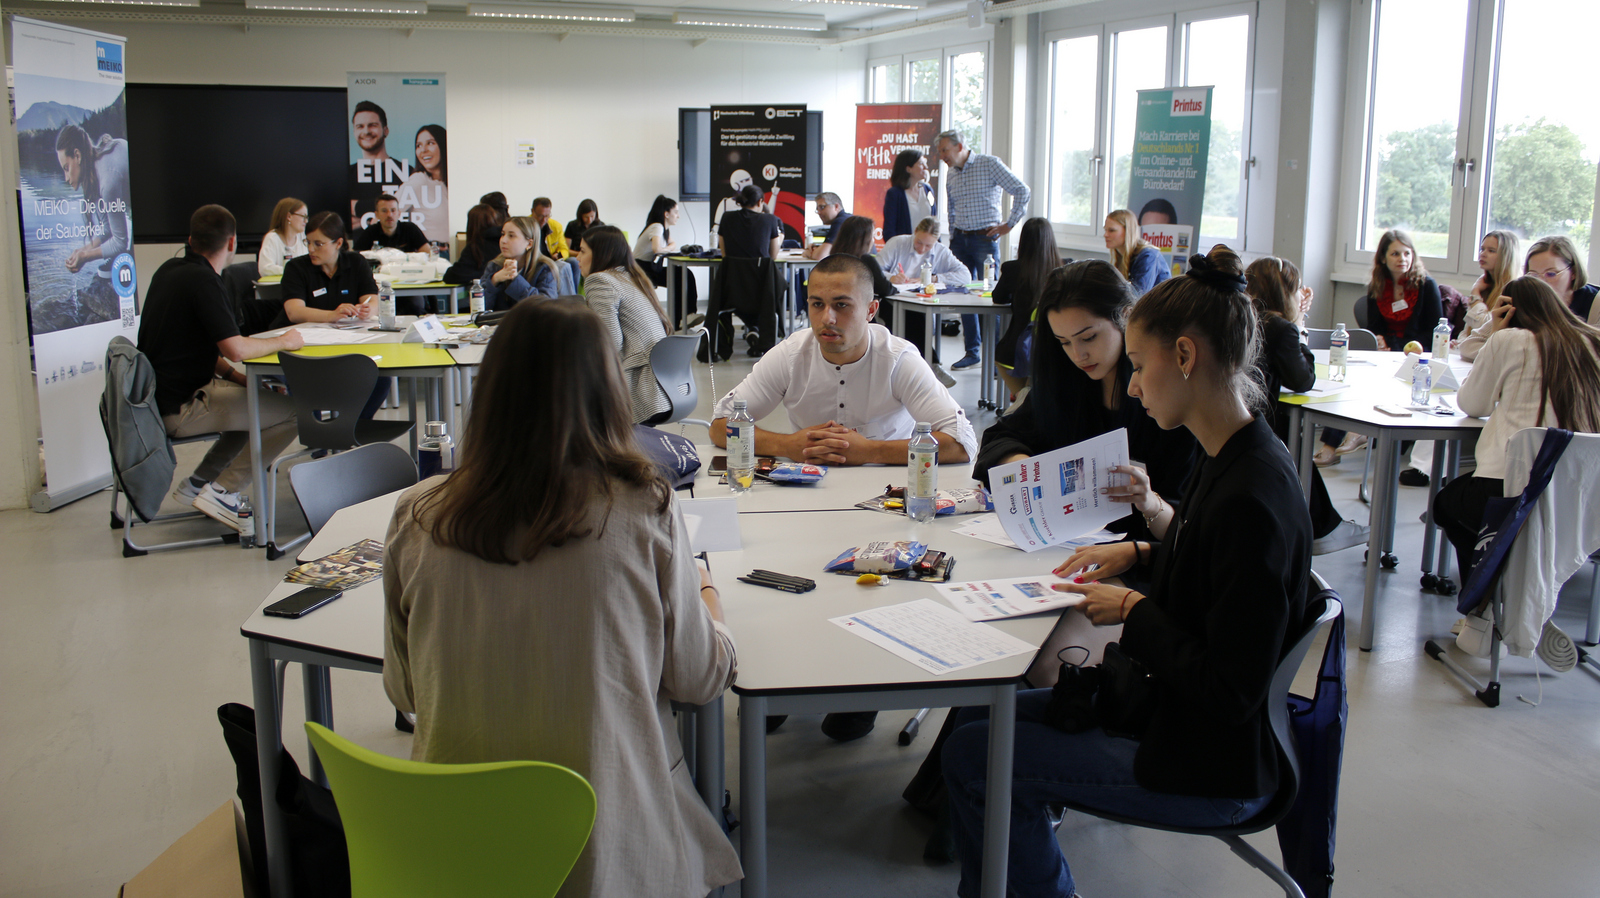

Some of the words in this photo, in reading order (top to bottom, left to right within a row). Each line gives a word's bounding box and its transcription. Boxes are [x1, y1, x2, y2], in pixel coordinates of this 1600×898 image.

[97, 60, 122, 72] MEIKO
[1173, 98, 1202, 112] Printus
[896, 134, 918, 143] HAST
[1140, 131, 1158, 141] Mach
[1160, 131, 1188, 141] Karriere
[1189, 130, 1200, 140] bei
[1137, 142, 1183, 153] Deutschlands
[1185, 143, 1194, 153] Nr.
[1195, 143, 1199, 153] 1
[858, 146, 891, 166] MEHR
[1140, 154, 1150, 165] im
[1152, 155, 1178, 165] Online-
[1179, 155, 1192, 166] und
[357, 158, 409, 183] EIN
[765, 168, 774, 176] KI
[1134, 167, 1184, 178] Versandhandel
[1186, 168, 1197, 178] für
[1143, 179, 1184, 190] Bürobedarf!
[382, 185, 442, 209] TAU
[34, 200, 69, 216] MEIKO
[80, 199, 96, 214] Die
[98, 198, 126, 213] Quelle
[36, 225, 53, 240] der
[56, 222, 105, 239] Sauberkeit
[1143, 232, 1173, 248] Printus
